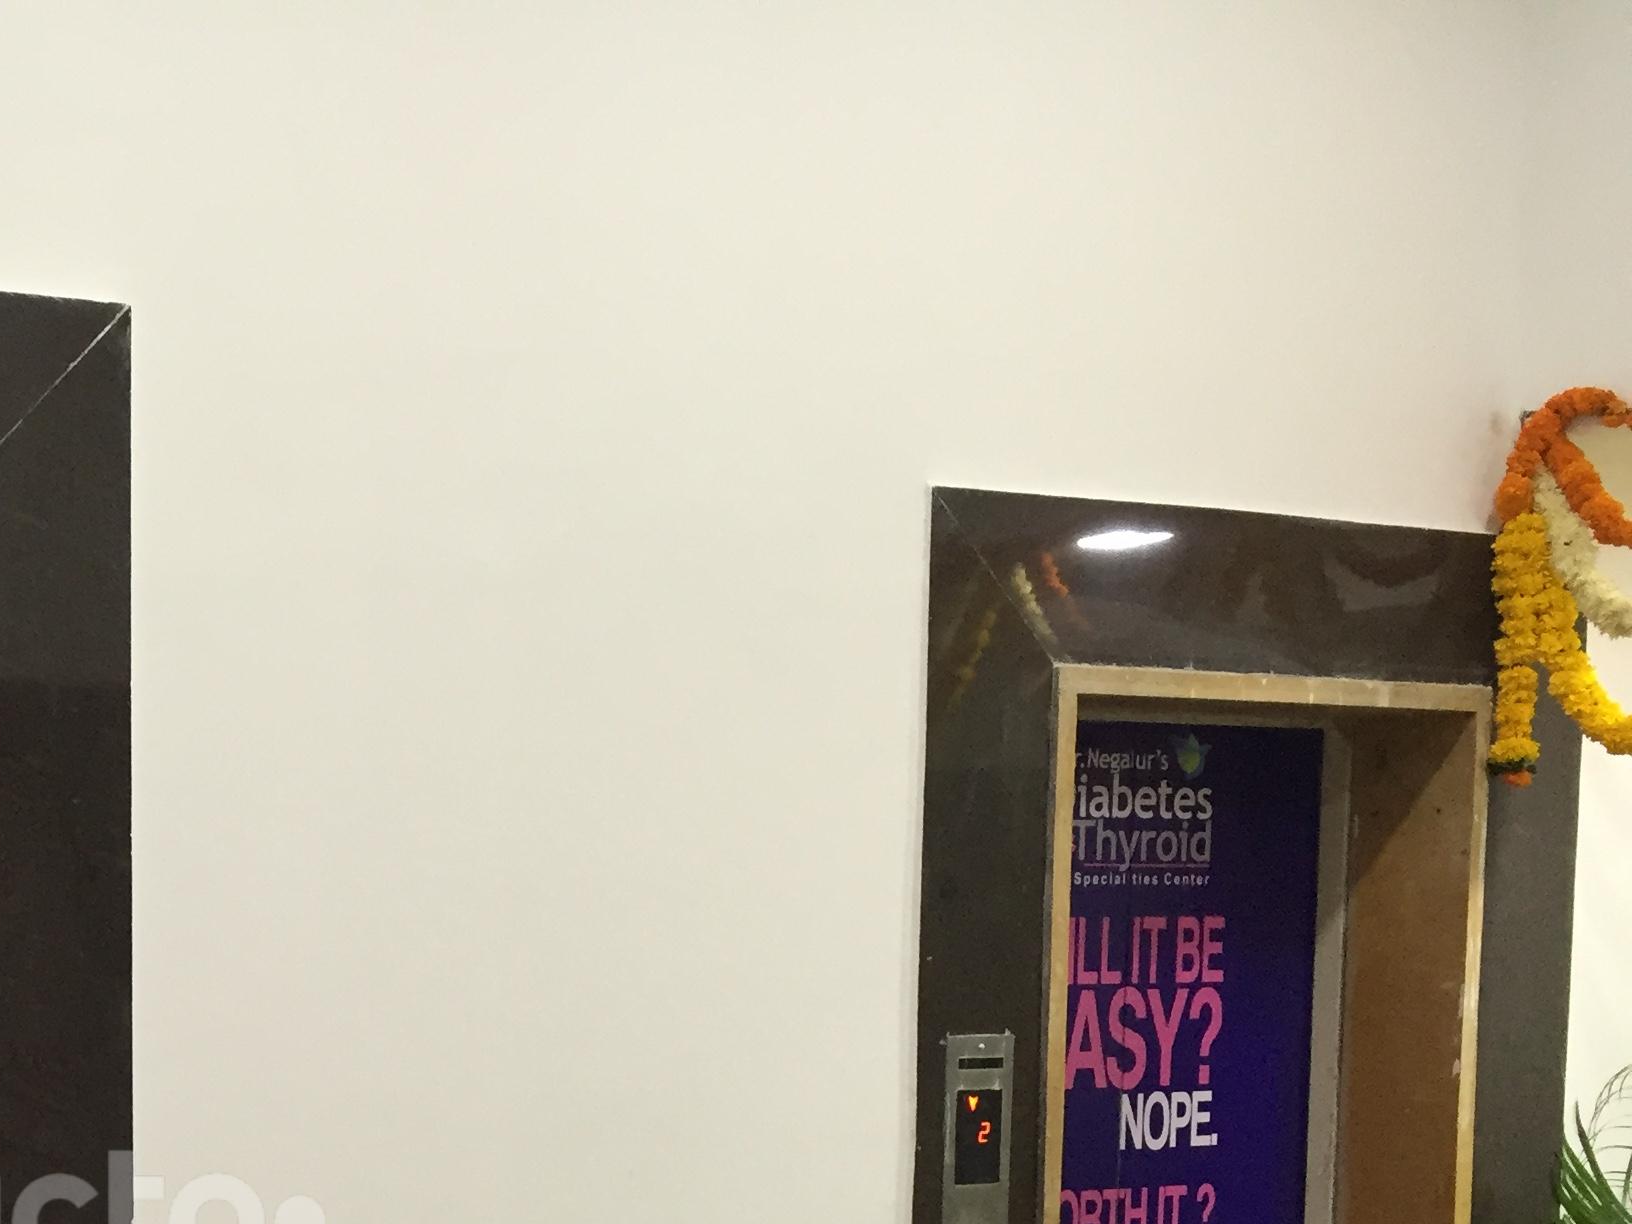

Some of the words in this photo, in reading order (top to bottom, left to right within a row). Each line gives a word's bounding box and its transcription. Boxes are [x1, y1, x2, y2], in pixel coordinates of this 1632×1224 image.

[1075, 772, 1213, 820] iabetes
[1072, 818, 1213, 871] Thyroid
[1164, 872, 1211, 887] Center
[1131, 916, 1167, 984] IT
[1175, 915, 1225, 984] BE
[1064, 986, 1223, 1090] ASY?
[977, 1121, 991, 1144] 2
[1119, 1090, 1218, 1150] NOPE.
